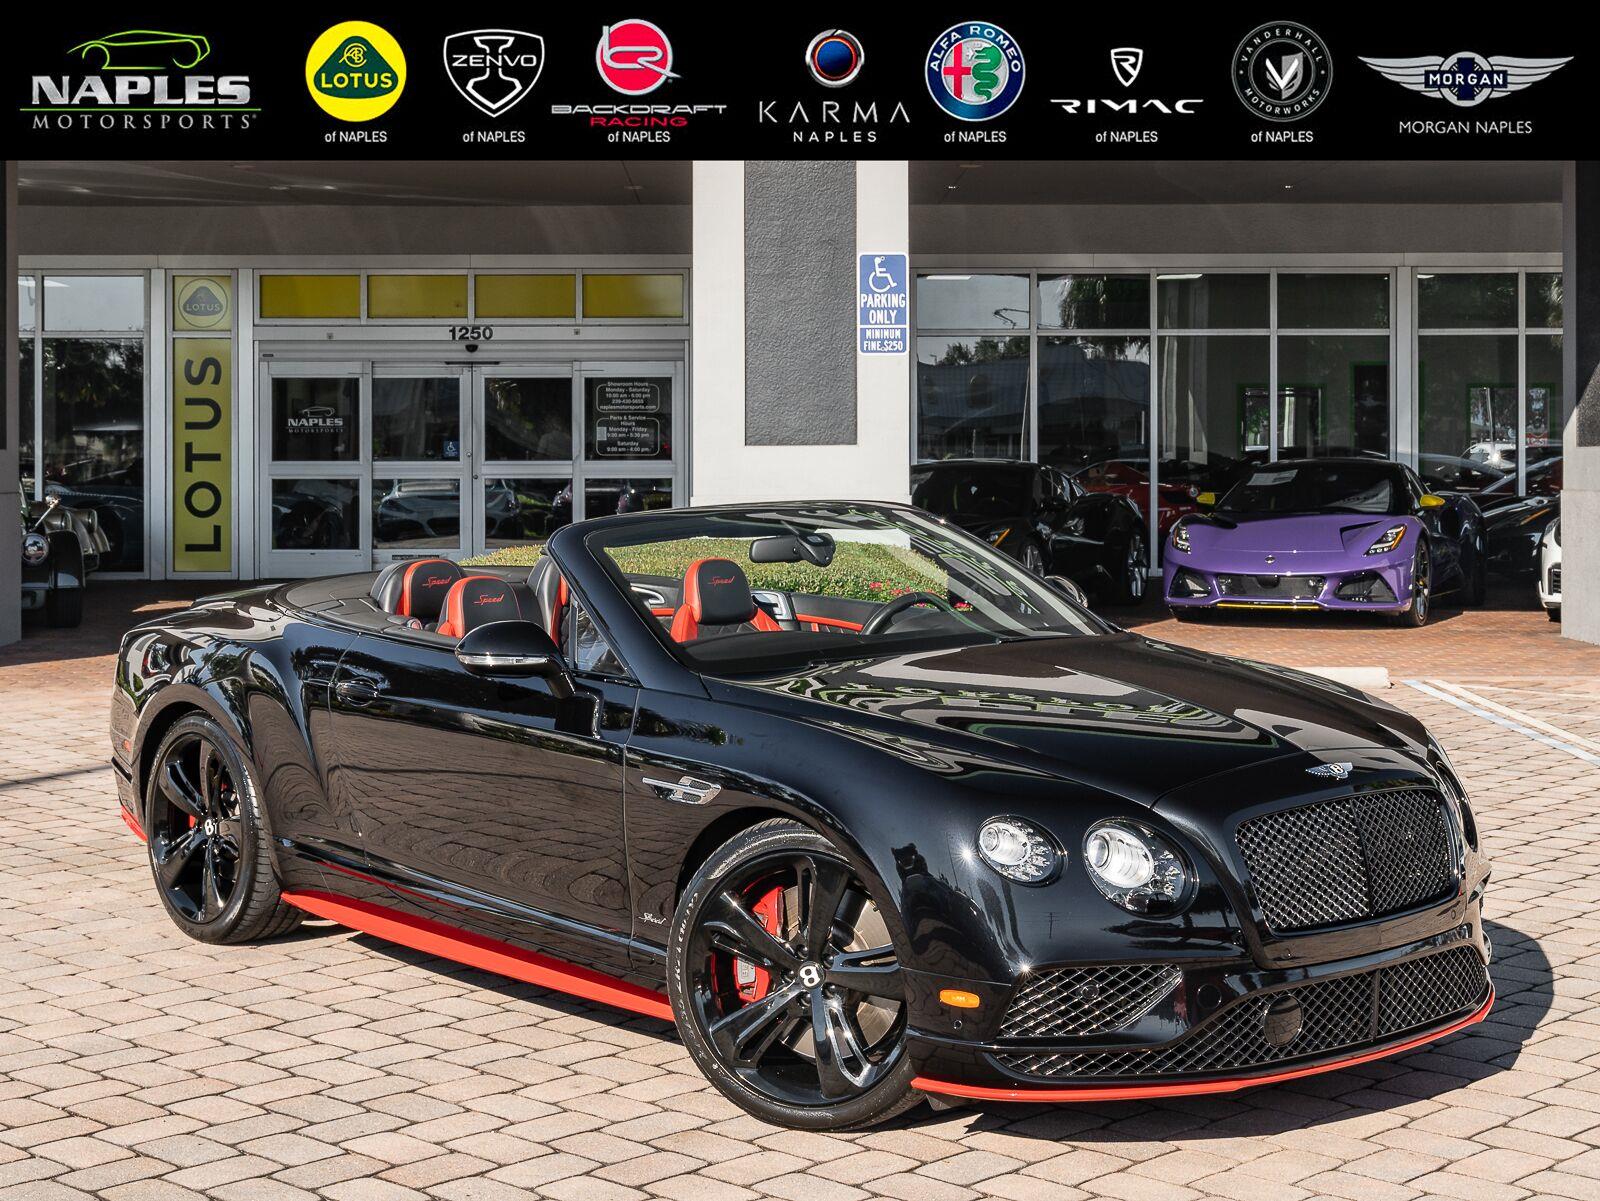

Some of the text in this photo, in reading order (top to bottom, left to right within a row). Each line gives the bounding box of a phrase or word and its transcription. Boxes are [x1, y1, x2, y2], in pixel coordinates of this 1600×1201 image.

[860, 293, 906, 308] PARKING
[186, 303, 221, 312] LOTUS
[869, 309, 897, 324] ONLY
[449, 325, 493, 341] 1250
[865, 328, 901, 340] MINIMUM
[863, 340, 904, 352] FINE $250
[288, 418, 343, 426] NAPLES
[184, 357, 222, 552] LOTUS
[422, 576, 452, 588] Speed
[706, 575, 736, 587] Speed
[473, 593, 505, 606] Speed
